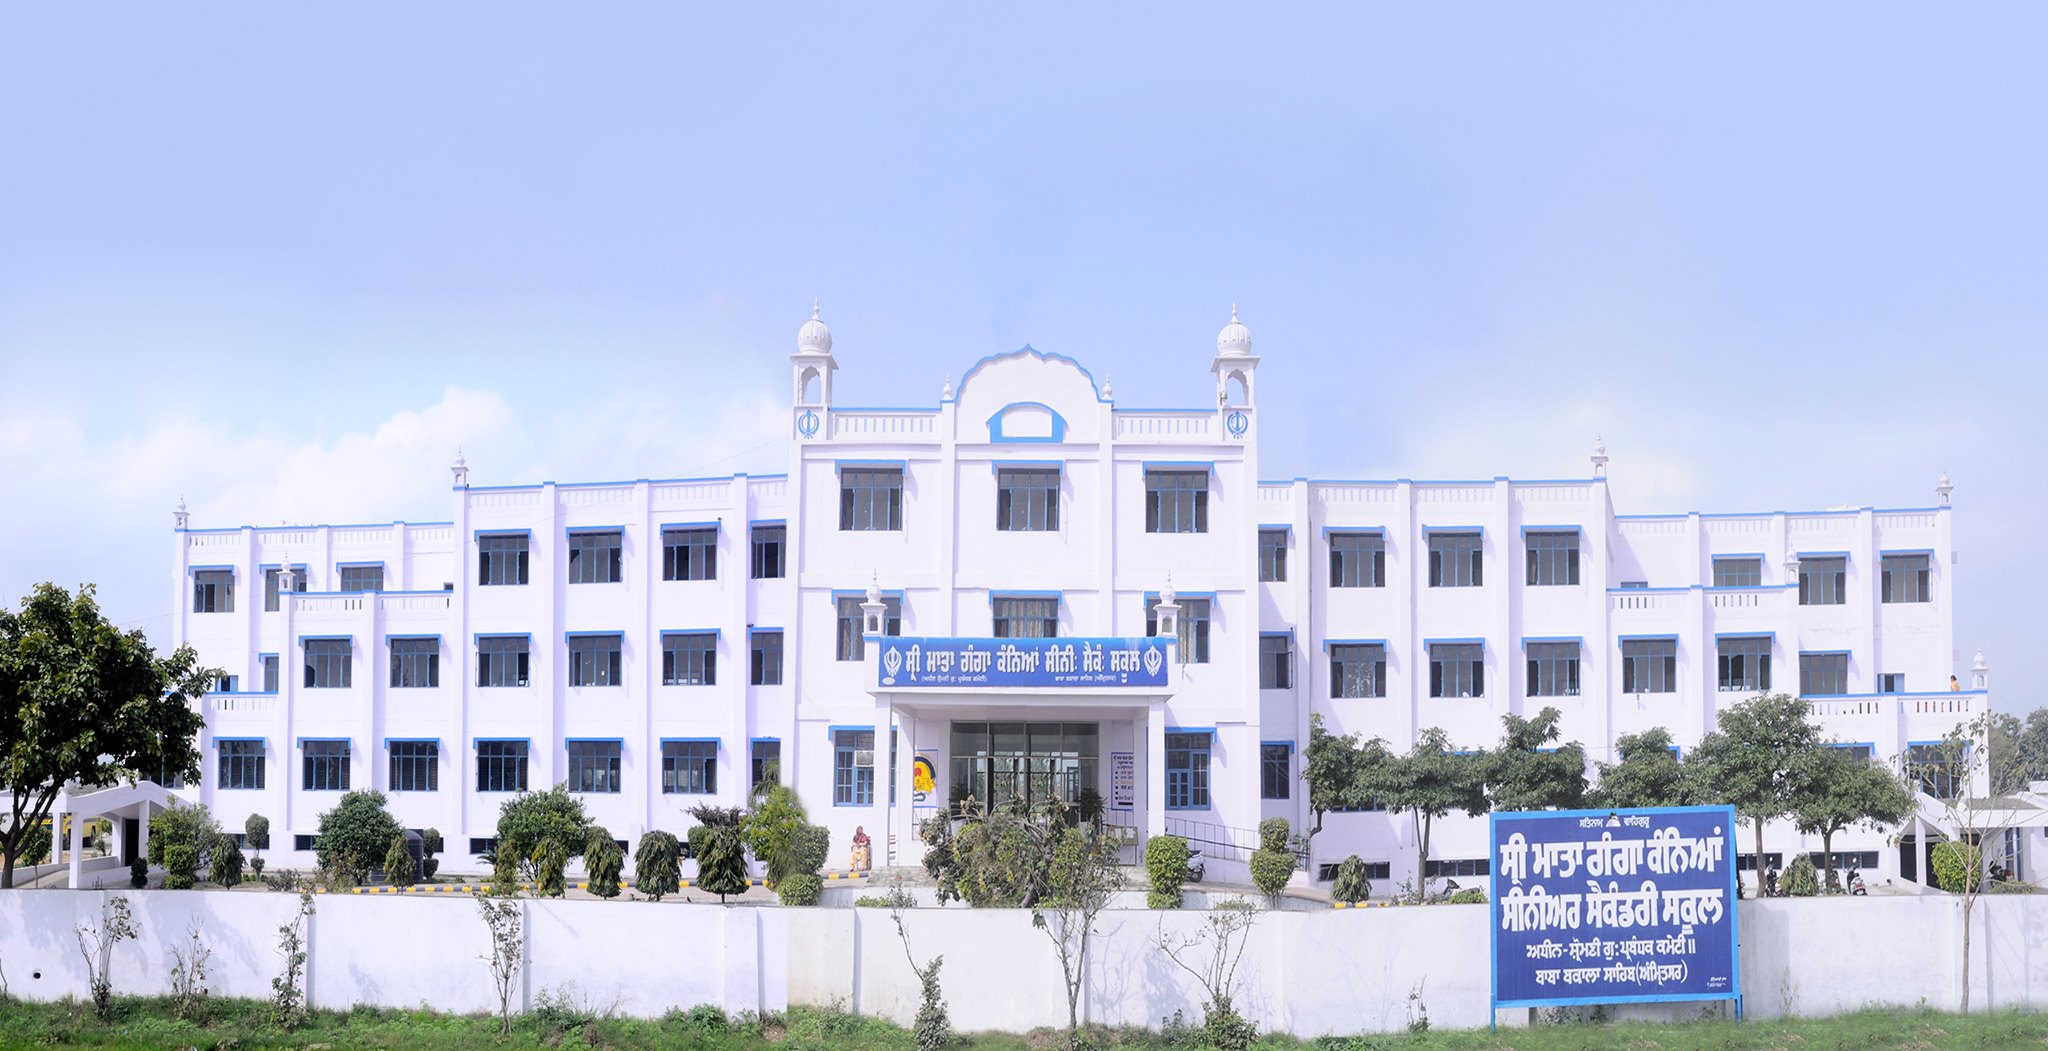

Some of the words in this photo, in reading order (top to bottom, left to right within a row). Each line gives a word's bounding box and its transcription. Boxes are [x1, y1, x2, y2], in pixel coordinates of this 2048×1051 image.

[905, 644, 921, 681] ਸ੍ਰੀ
[926, 651, 955, 673] ਮਾਤਾ
[960, 644, 991, 673] ਗੰਗਾ
[997, 644, 1040, 673] ਕੰਨਿਆਂ
[1110, 650, 1140, 683] ਸਕੂਲ
[1500, 832, 1528, 885] ਸ੍ਰੀ
[1532, 841, 1584, 878] ਮਾਤਾ
[1586, 831, 1644, 876] ਗੰਗਾ
[1646, 826, 1724, 874] ਕੰਨਿਆਂ
[1501, 885, 1582, 931] ਸੀਨੀਅਰ
[1586, 880, 1658, 928] ਸੈਕੰਡਰੀ
[1662, 888, 1724, 935] ਸਕੂਲ
[1535, 969, 1561, 985] ਬਾਬਾ
[1563, 968, 1601, 984] ਬਕਾਲਾ
